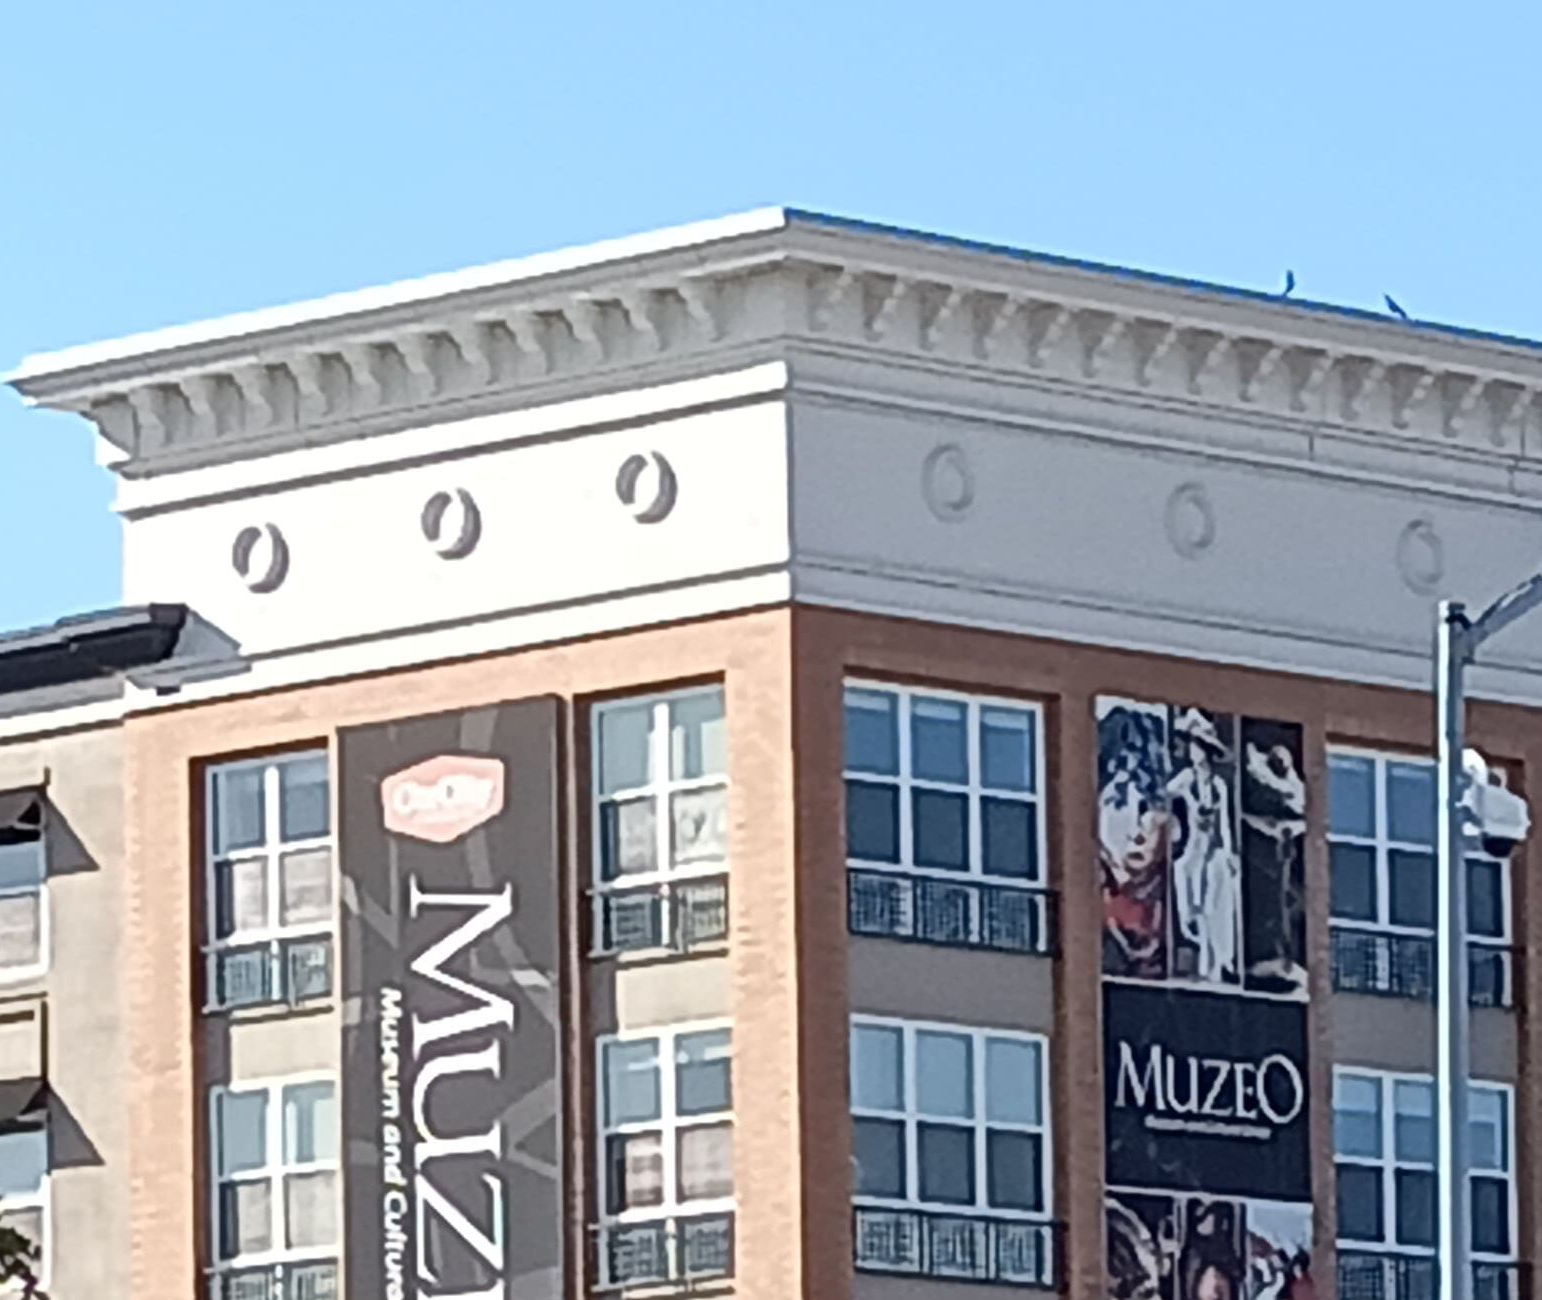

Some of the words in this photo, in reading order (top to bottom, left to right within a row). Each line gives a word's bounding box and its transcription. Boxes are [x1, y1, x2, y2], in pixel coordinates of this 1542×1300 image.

[380, 987, 403, 1119] Museum
[1114, 1041, 1304, 1124] MUZEO
[383, 1123, 407, 1186] and
